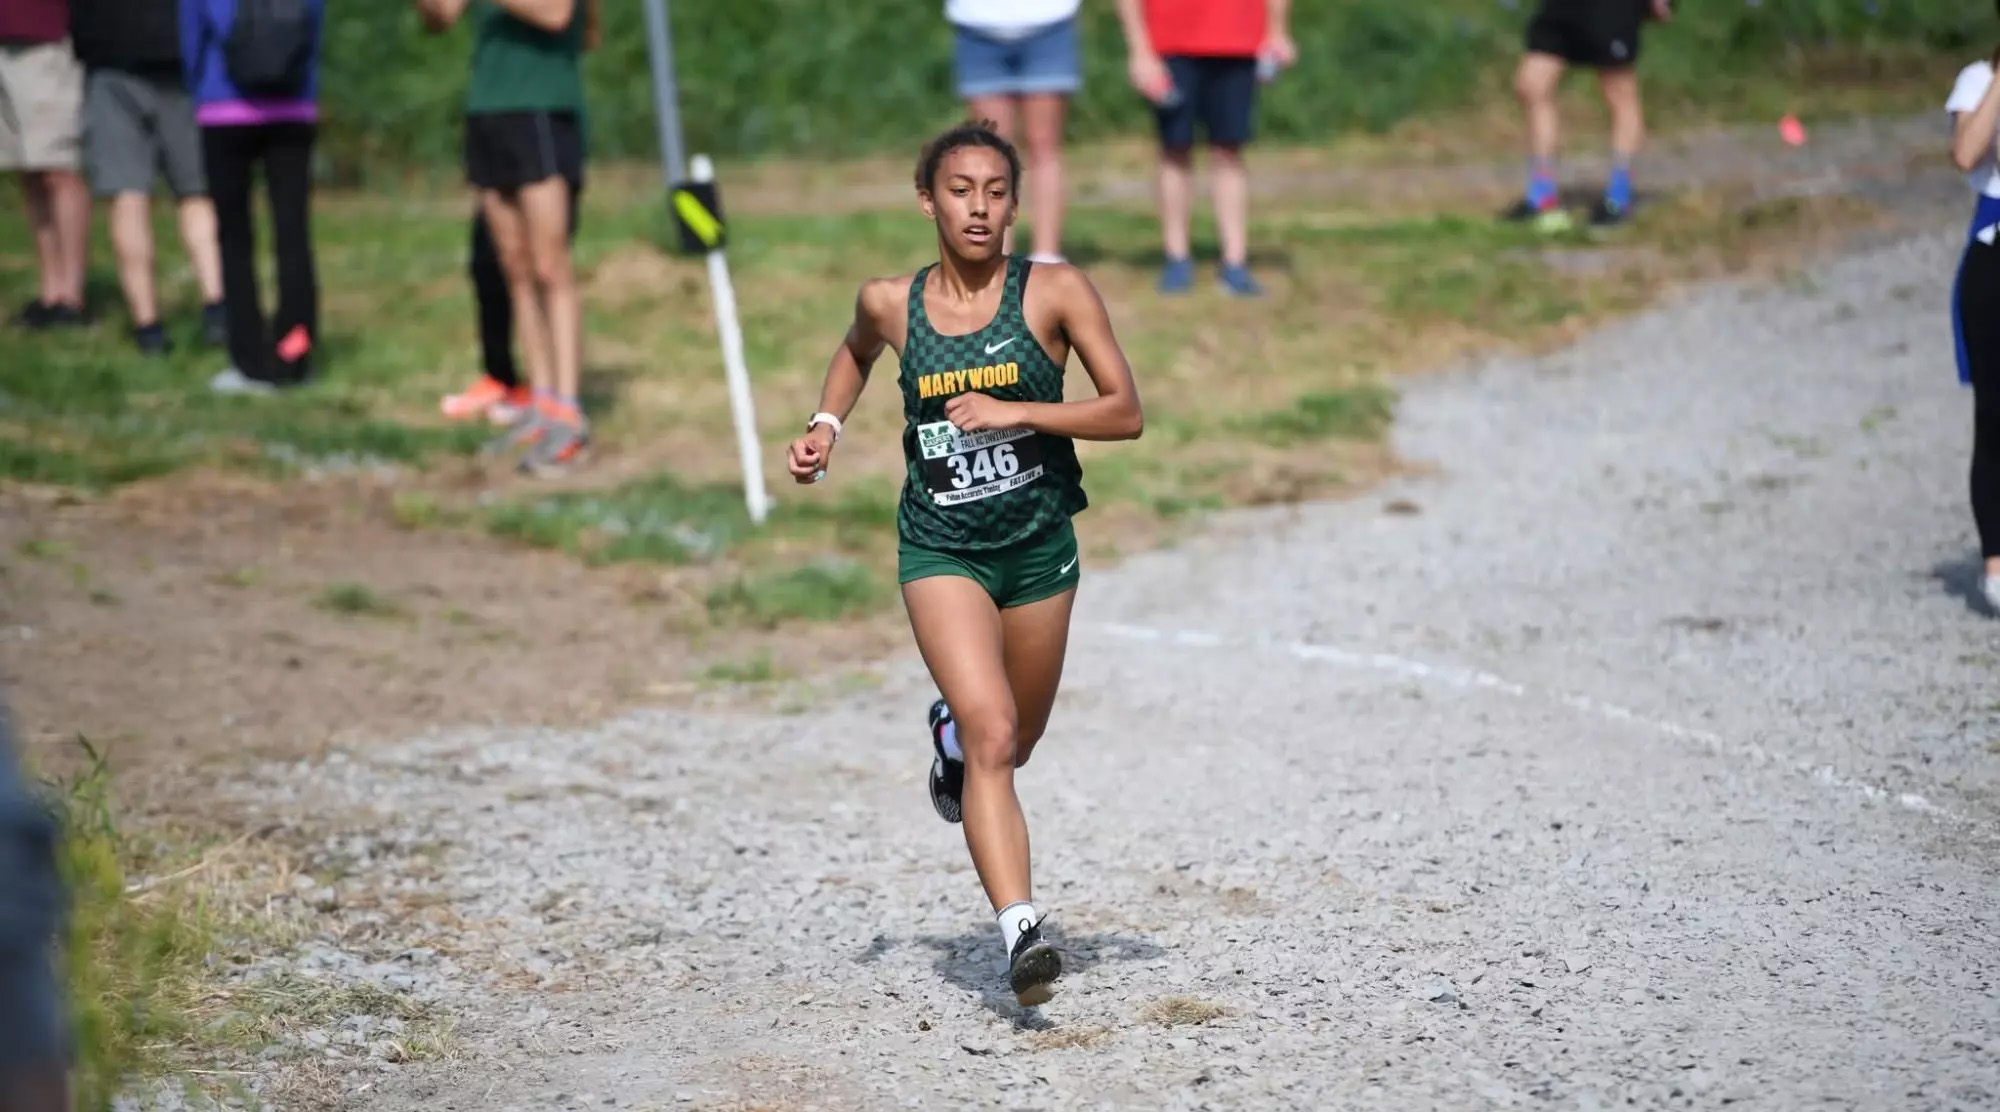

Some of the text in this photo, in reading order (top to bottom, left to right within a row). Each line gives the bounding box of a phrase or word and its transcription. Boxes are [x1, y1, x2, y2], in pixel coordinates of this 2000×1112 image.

[918, 362, 1018, 399] MARYWOOD
[961, 437, 975, 449] FALL
[984, 428, 1031, 444] INVITATIO
[947, 443, 1019, 489] 346
[961, 488, 983, 500] Accurate
